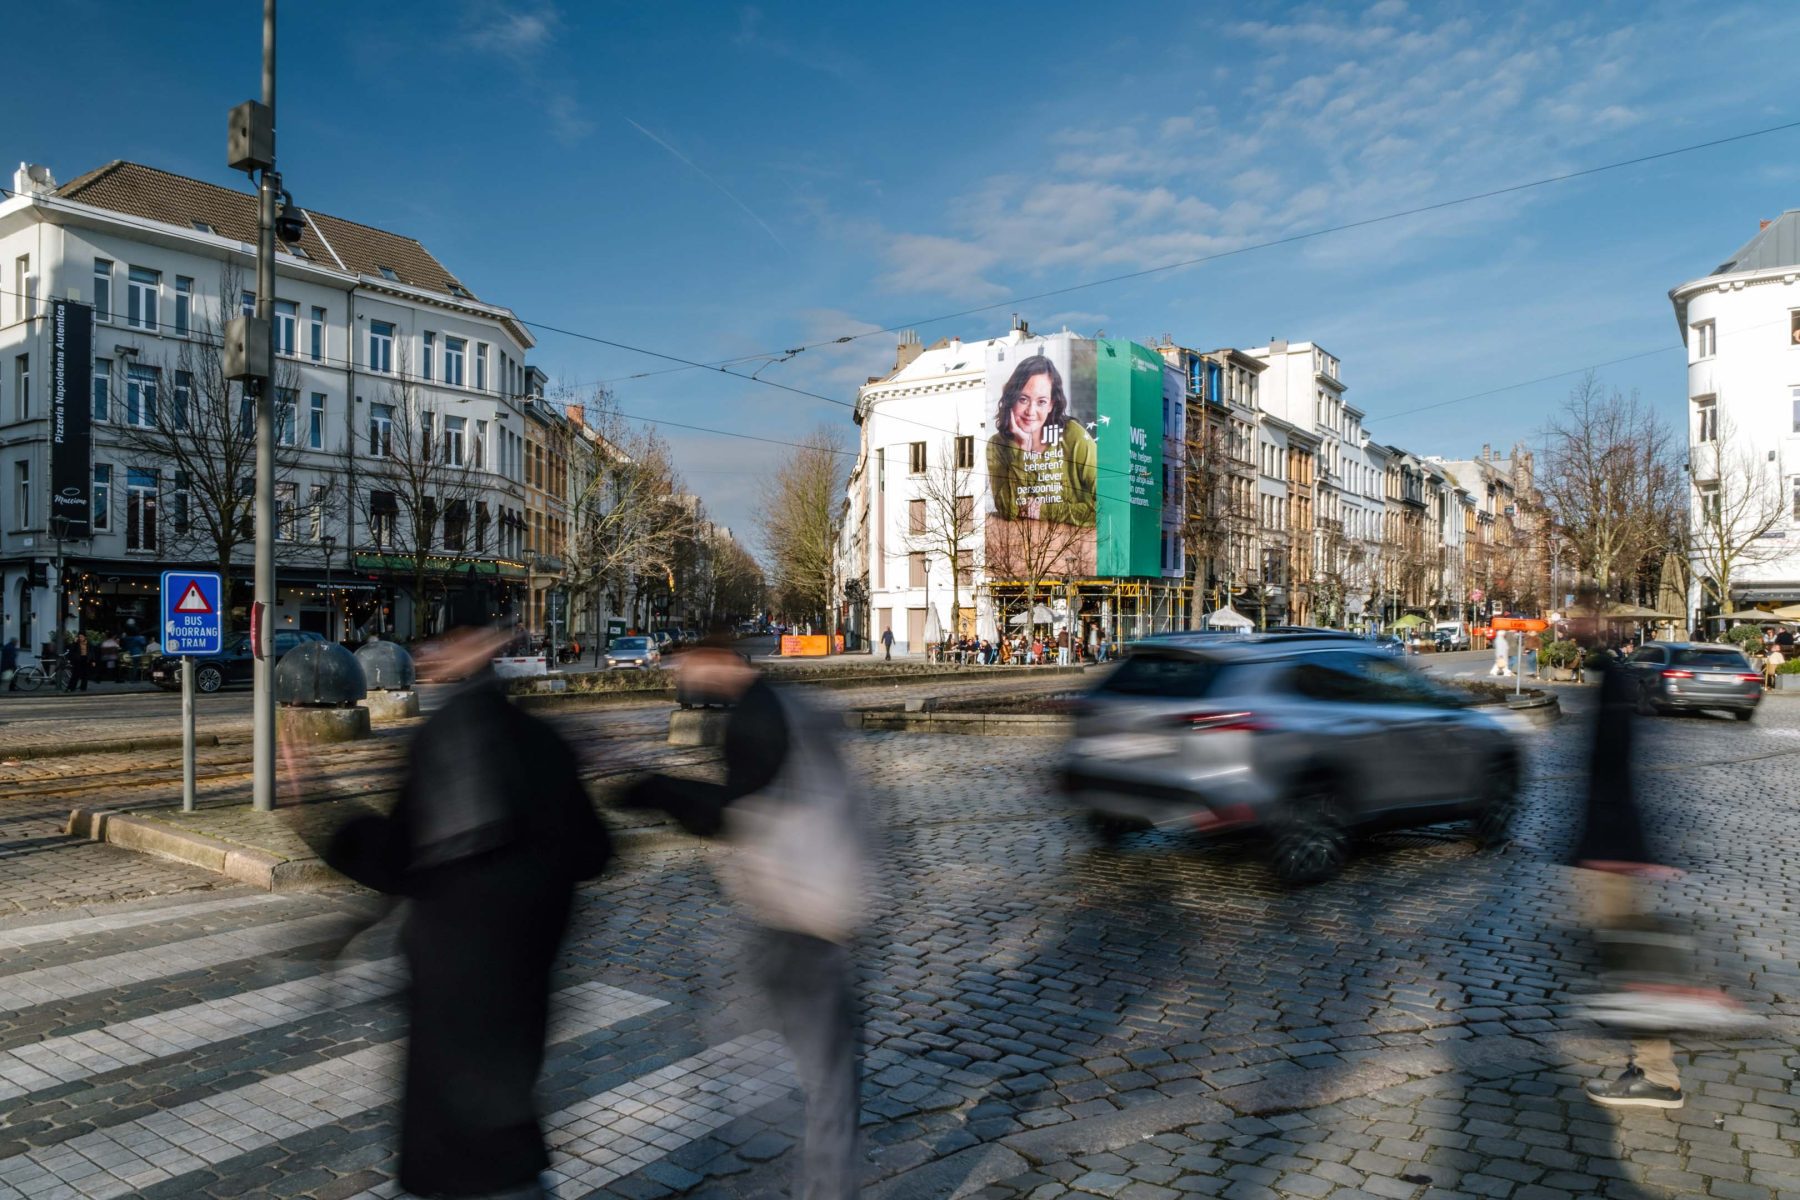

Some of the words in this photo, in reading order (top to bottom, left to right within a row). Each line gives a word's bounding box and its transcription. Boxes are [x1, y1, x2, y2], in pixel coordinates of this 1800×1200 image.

[55, 304, 65, 350] Autentica
[55, 351, 66, 404] Napoletana
[55, 406, 64, 443] Pizzeria
[1041, 424, 1063, 447] Jij:
[1130, 426, 1147, 450] Wij:
[1023, 451, 1042, 463] Mijn
[1044, 448, 1064, 460] geld
[1024, 460, 1064, 471] beheren?
[1038, 472, 1064, 481] Liever
[1017, 483, 1063, 495] persoonlijk
[1034, 494, 1063, 504] online.
[185, 616, 203, 626] BUS
[170, 626, 218, 637] VOORRANG
[181, 638, 207, 648] TRAM
